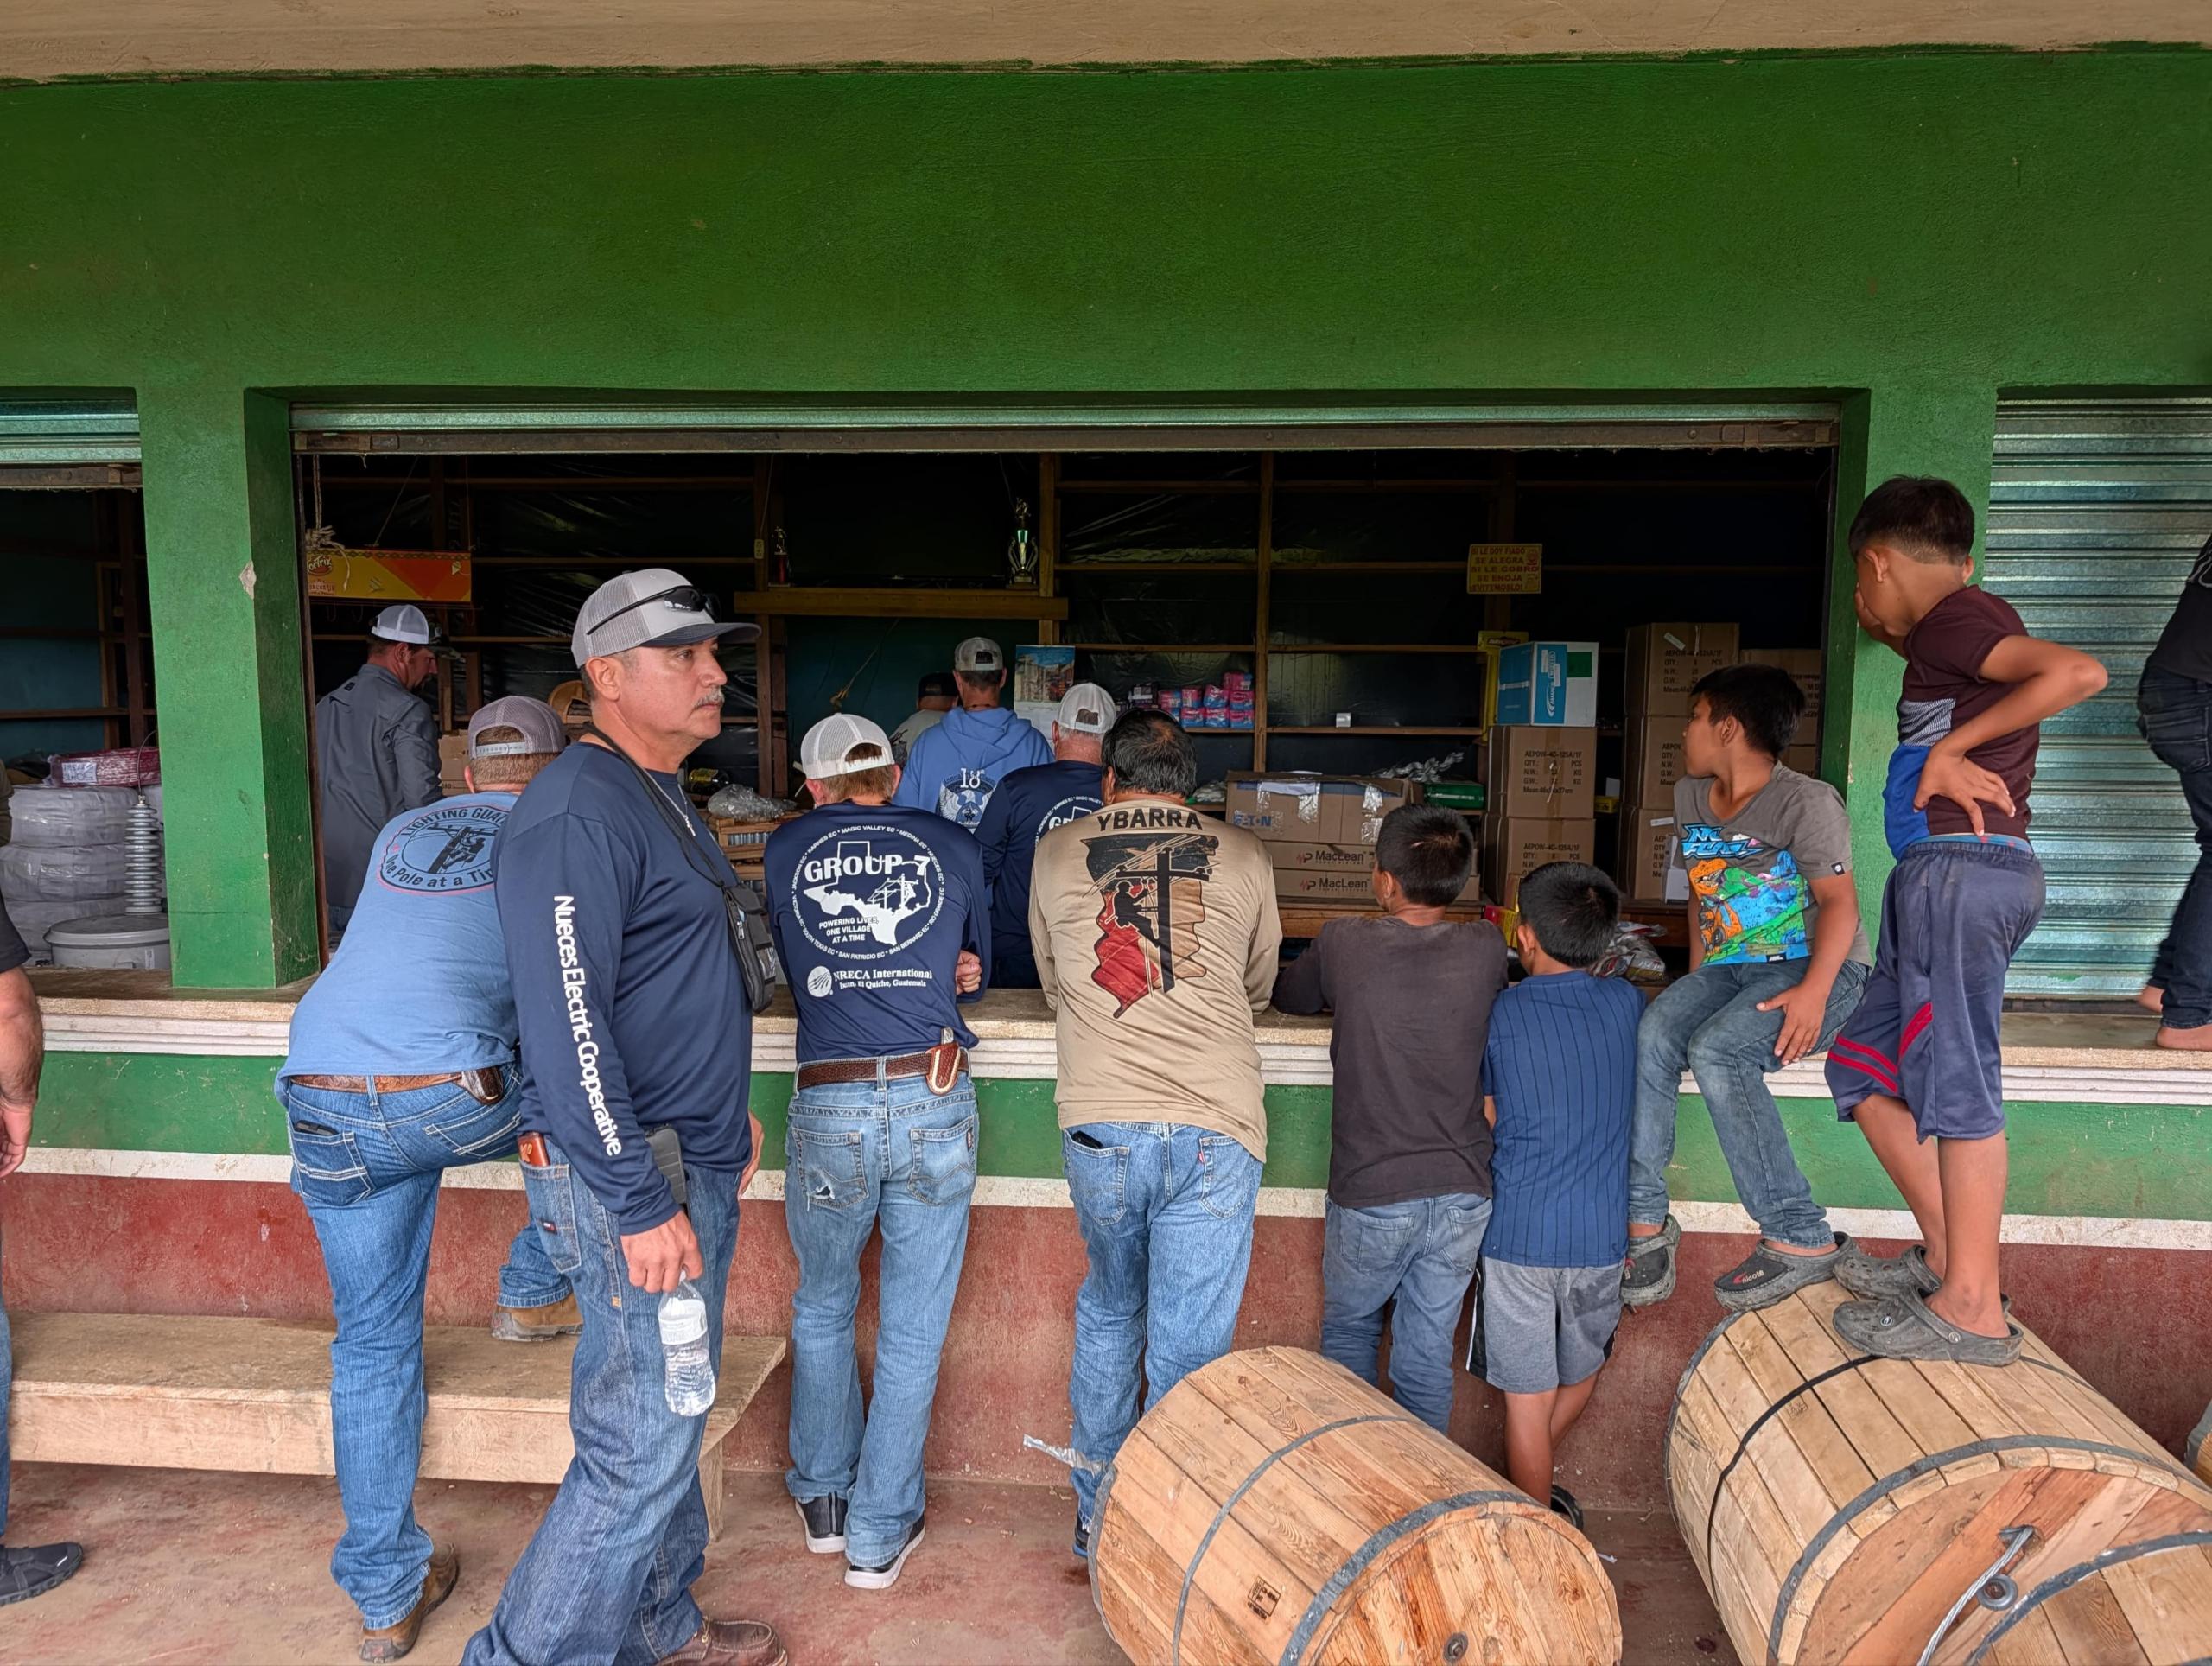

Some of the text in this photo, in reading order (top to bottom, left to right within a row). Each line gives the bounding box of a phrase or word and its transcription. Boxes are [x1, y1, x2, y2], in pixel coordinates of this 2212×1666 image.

[401, 808, 468, 836] LIGHTING
[1097, 808, 1203, 832] YBARRA
[841, 825, 862, 834] MAGIC
[899, 830, 928, 849] MEDINA EC
[1315, 850, 1363, 861] MacLean
[804, 854, 931, 883] GROUP 7
[393, 868, 423, 886] Pole
[427, 877, 448, 887] at
[454, 876, 463, 886] a
[1319, 877, 1368, 888] MacLean
[818, 917, 855, 930] POWERING
[826, 928, 841, 937] ONE
[814, 938, 828, 952] TEXAS
[888, 944, 901, 955] SAN
[838, 951, 850, 959] SAN
[833, 968, 933, 982] NRECA International
[892, 979, 927, 988] Guatemala
[554, 895, 622, 1157] Nueces Electric Cooperative
